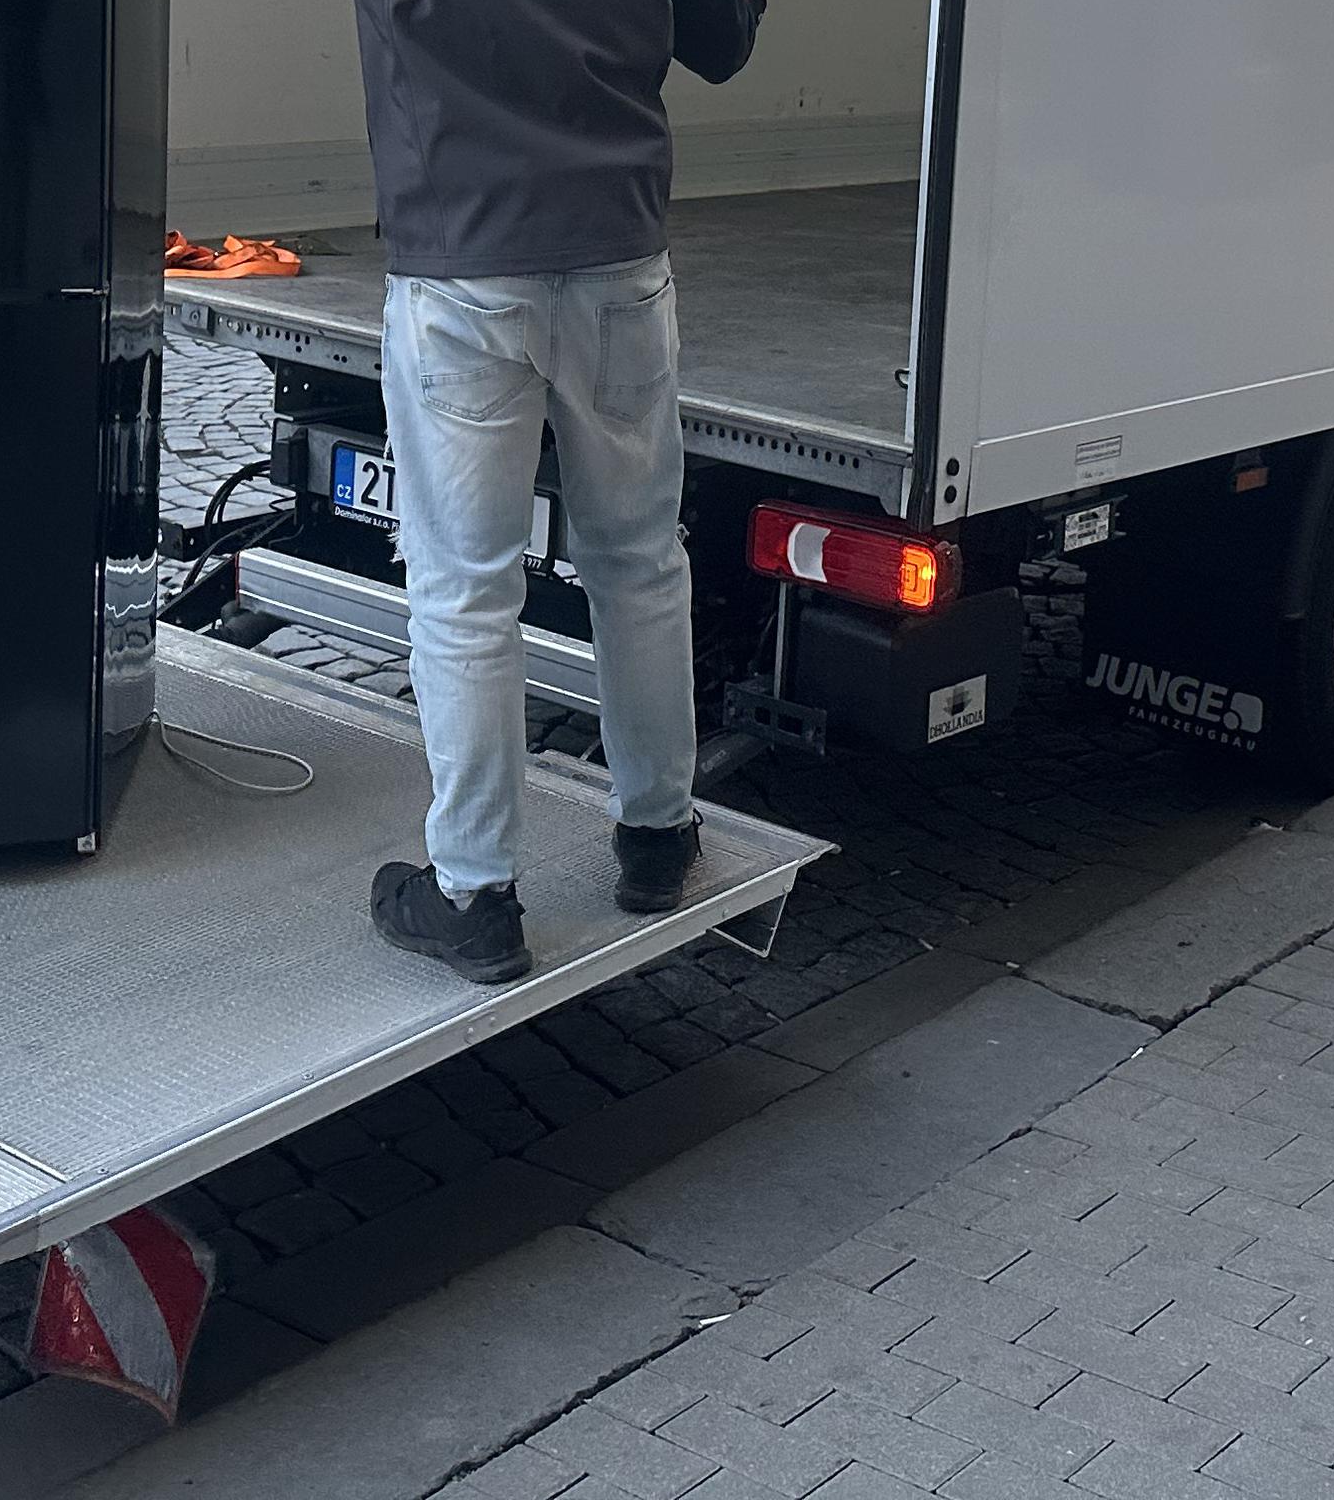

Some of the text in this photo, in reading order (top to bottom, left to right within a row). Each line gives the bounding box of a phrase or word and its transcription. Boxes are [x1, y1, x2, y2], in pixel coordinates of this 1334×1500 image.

[337, 460, 396, 512] CZ 2T
[334, 505, 371, 524] Dominator
[527, 557, 543, 569] 977
[1085, 653, 1228, 723] JUNGE
[929, 709, 984, 740] DHOLLANDIA
[1127, 705, 1257, 751] FAHRZEUGBAU
